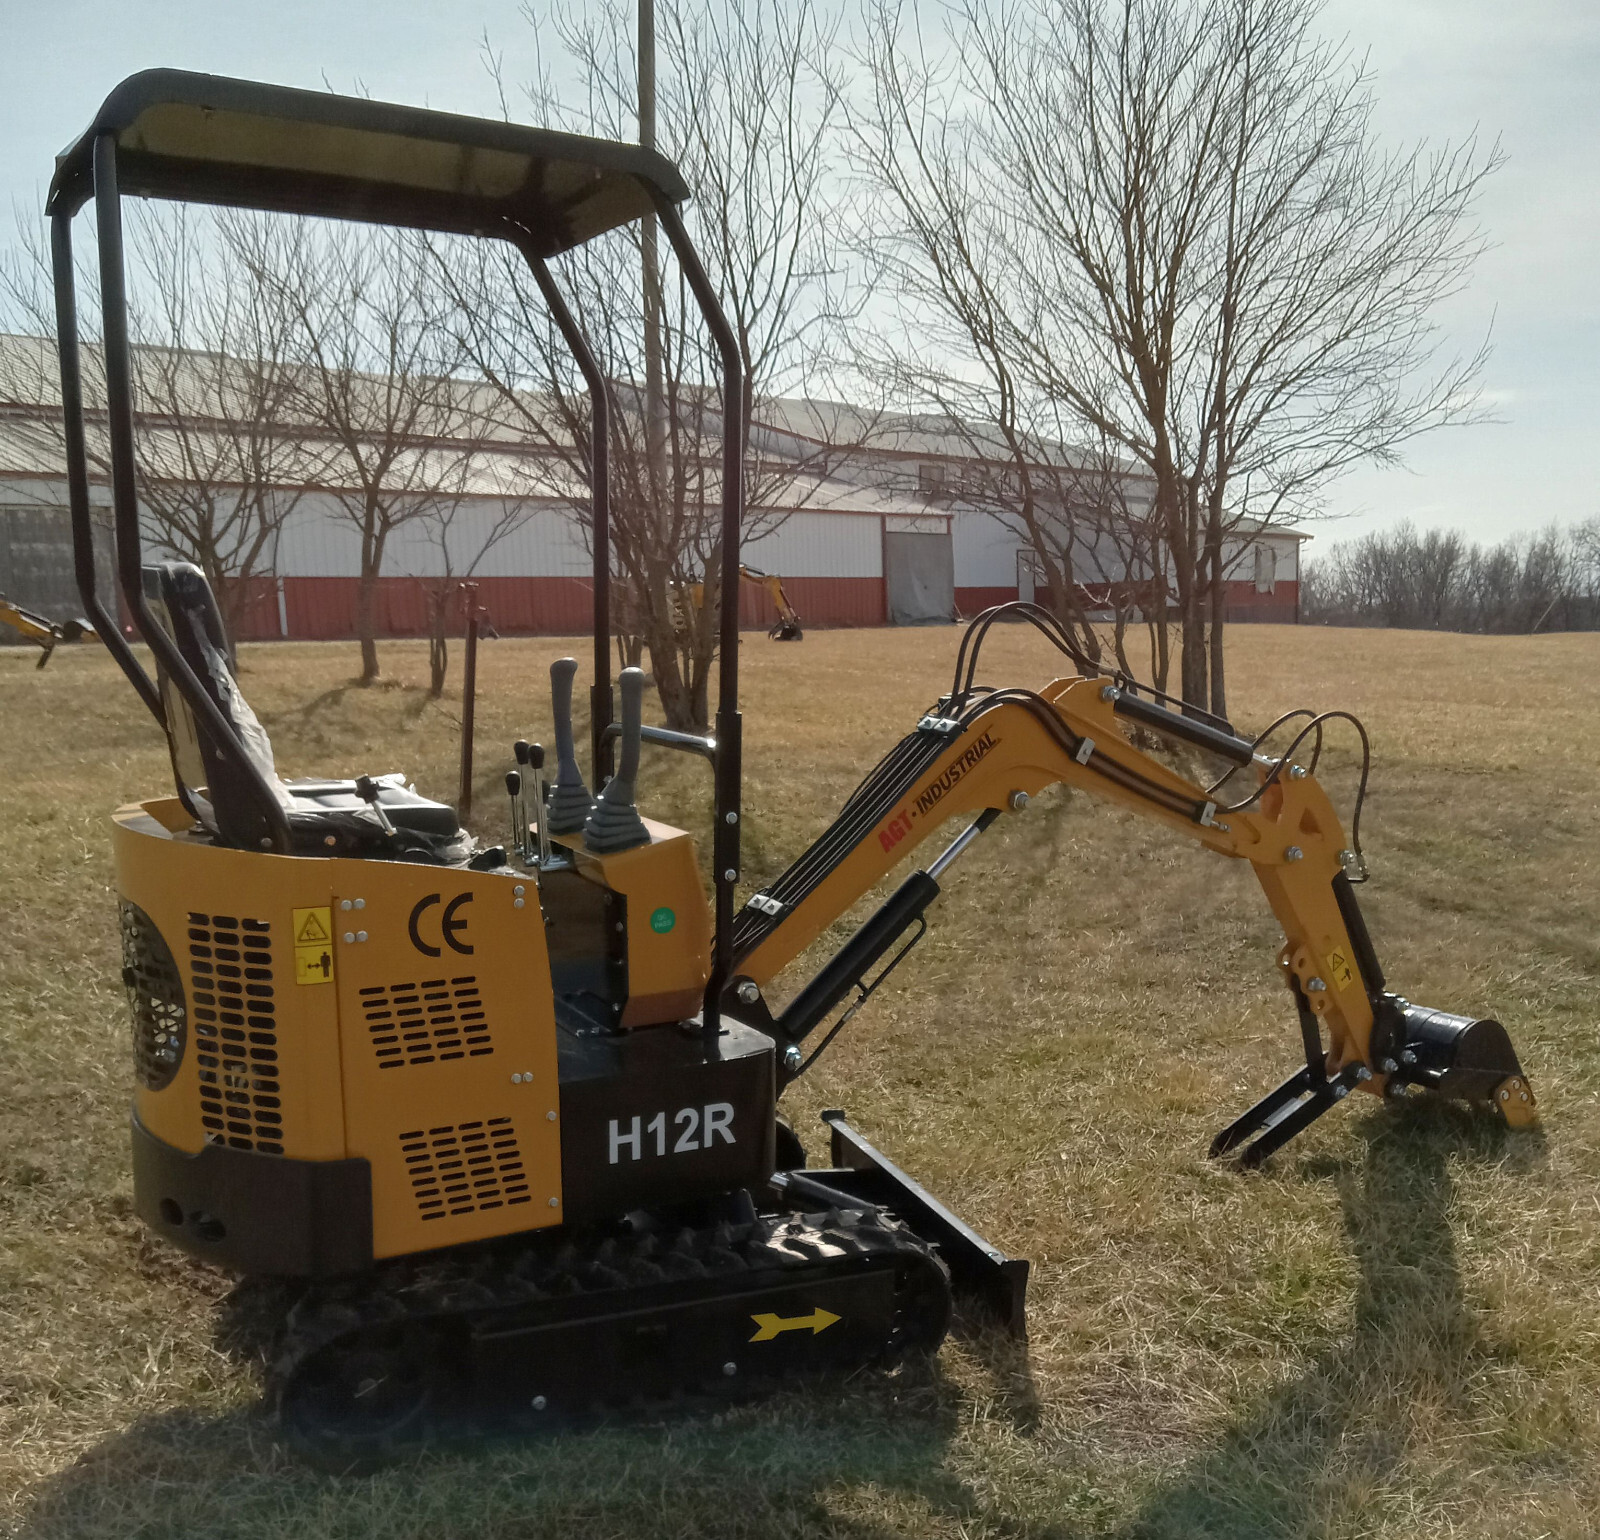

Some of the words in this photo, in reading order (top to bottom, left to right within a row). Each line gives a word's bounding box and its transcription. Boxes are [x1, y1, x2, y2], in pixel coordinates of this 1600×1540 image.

[878, 809, 913, 854] AGT
[916, 733, 997, 814] INDUSTRIAL
[408, 892, 474, 957] CE
[609, 1103, 736, 1164] H12R
